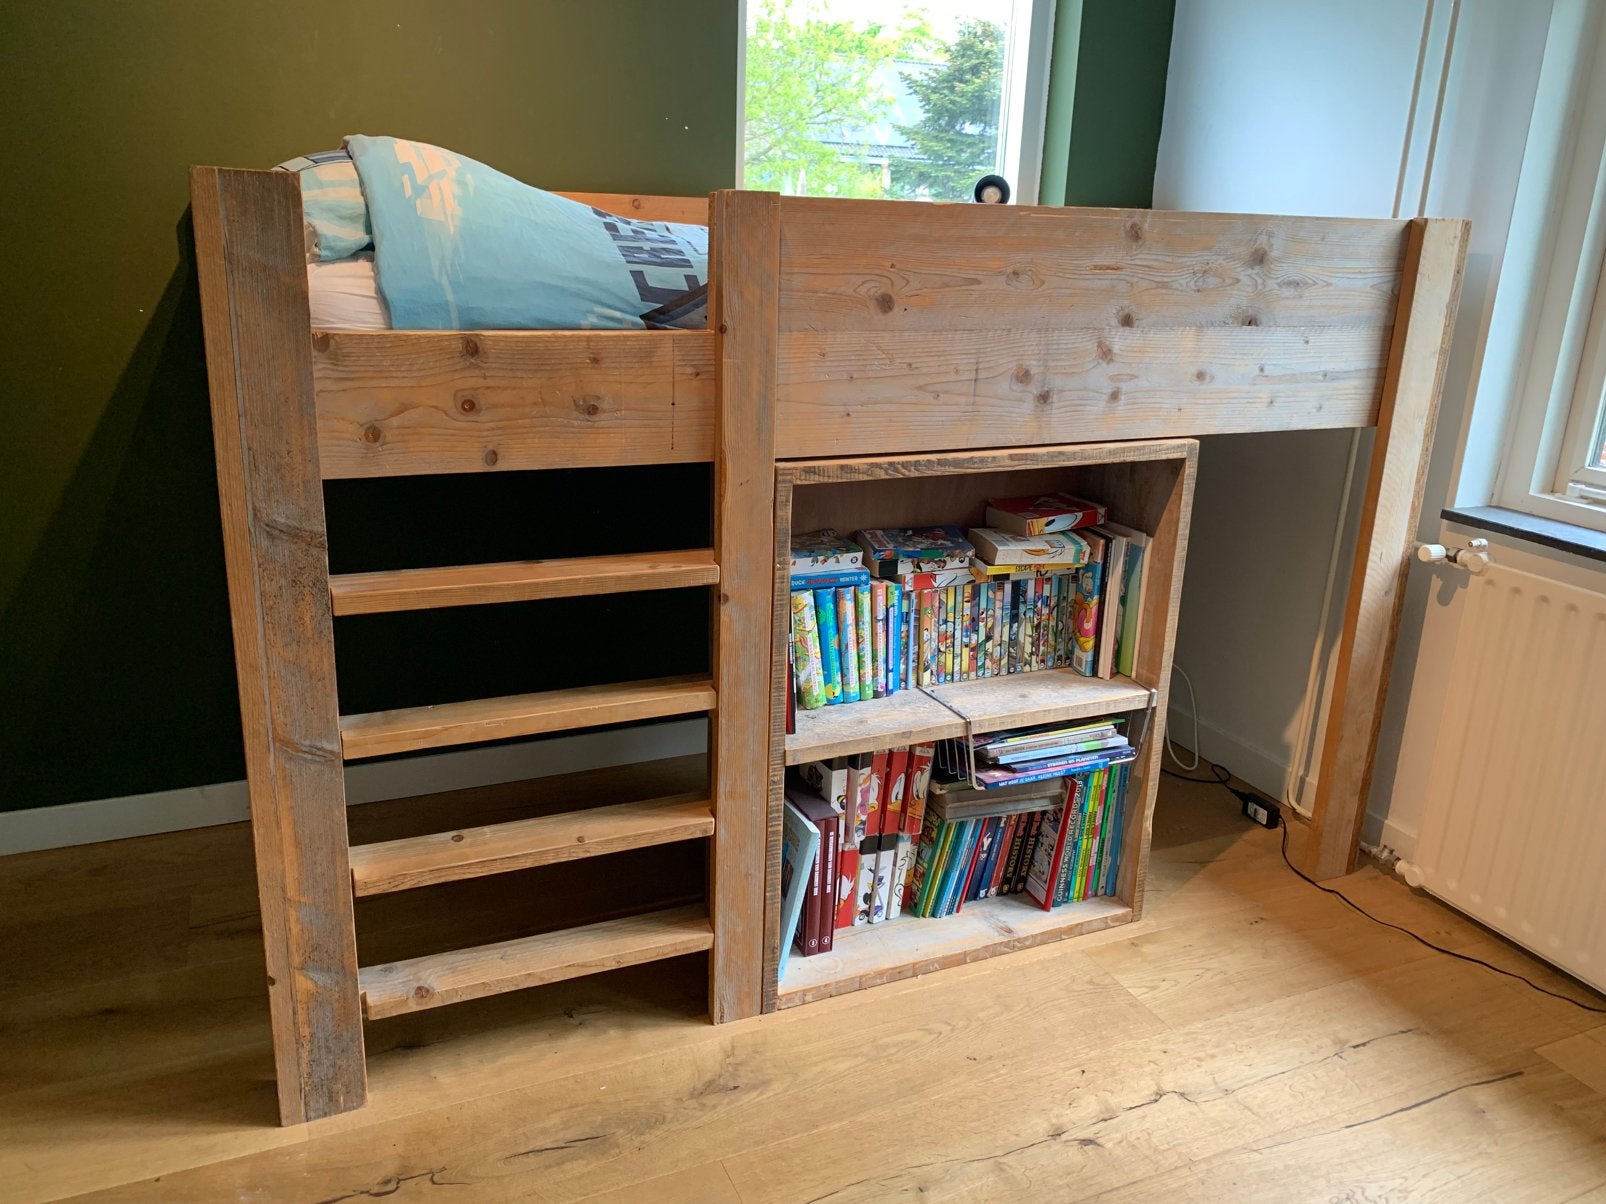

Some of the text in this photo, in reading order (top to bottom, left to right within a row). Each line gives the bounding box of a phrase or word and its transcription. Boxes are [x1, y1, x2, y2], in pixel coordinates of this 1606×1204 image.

[1068, 800, 1080, 835] RECORDS
[1006, 837, 1022, 878] HISTORY
[1021, 837, 1036, 877] HISTORY
[1063, 835, 1074, 862] WORLD
[1057, 861, 1069, 902] GUINNESS
